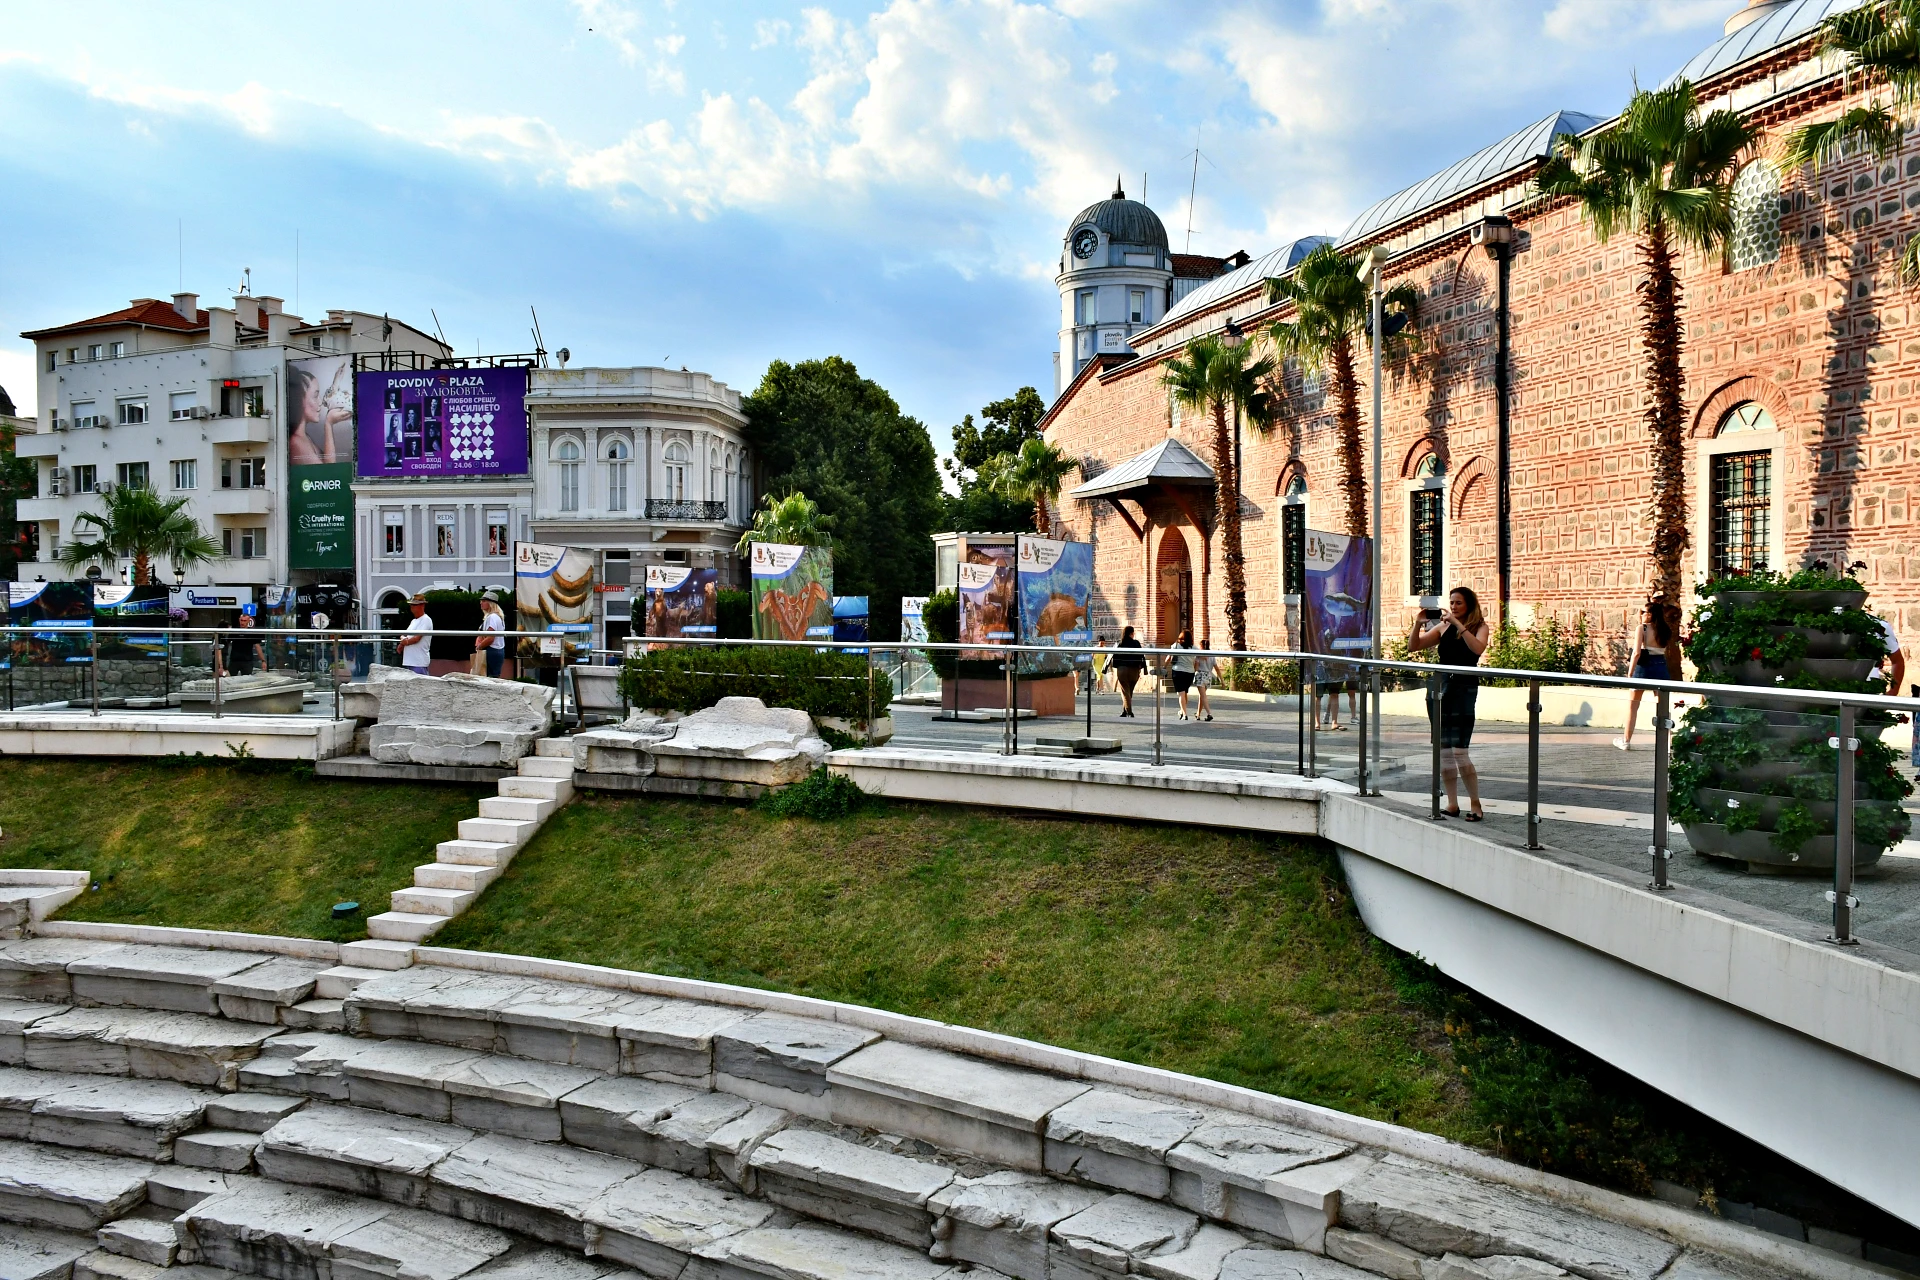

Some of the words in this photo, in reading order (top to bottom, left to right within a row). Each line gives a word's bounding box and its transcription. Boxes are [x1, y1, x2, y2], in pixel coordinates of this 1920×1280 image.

[388, 378, 434, 388] PLOVDIV
[450, 377, 484, 386] PLAZA
[414, 388, 428, 396] ЗА
[448, 404, 500, 412] НАСИЛИЕТО
[302, 480, 341, 491] GARNIER
[312, 514, 331, 522] Cruelty
